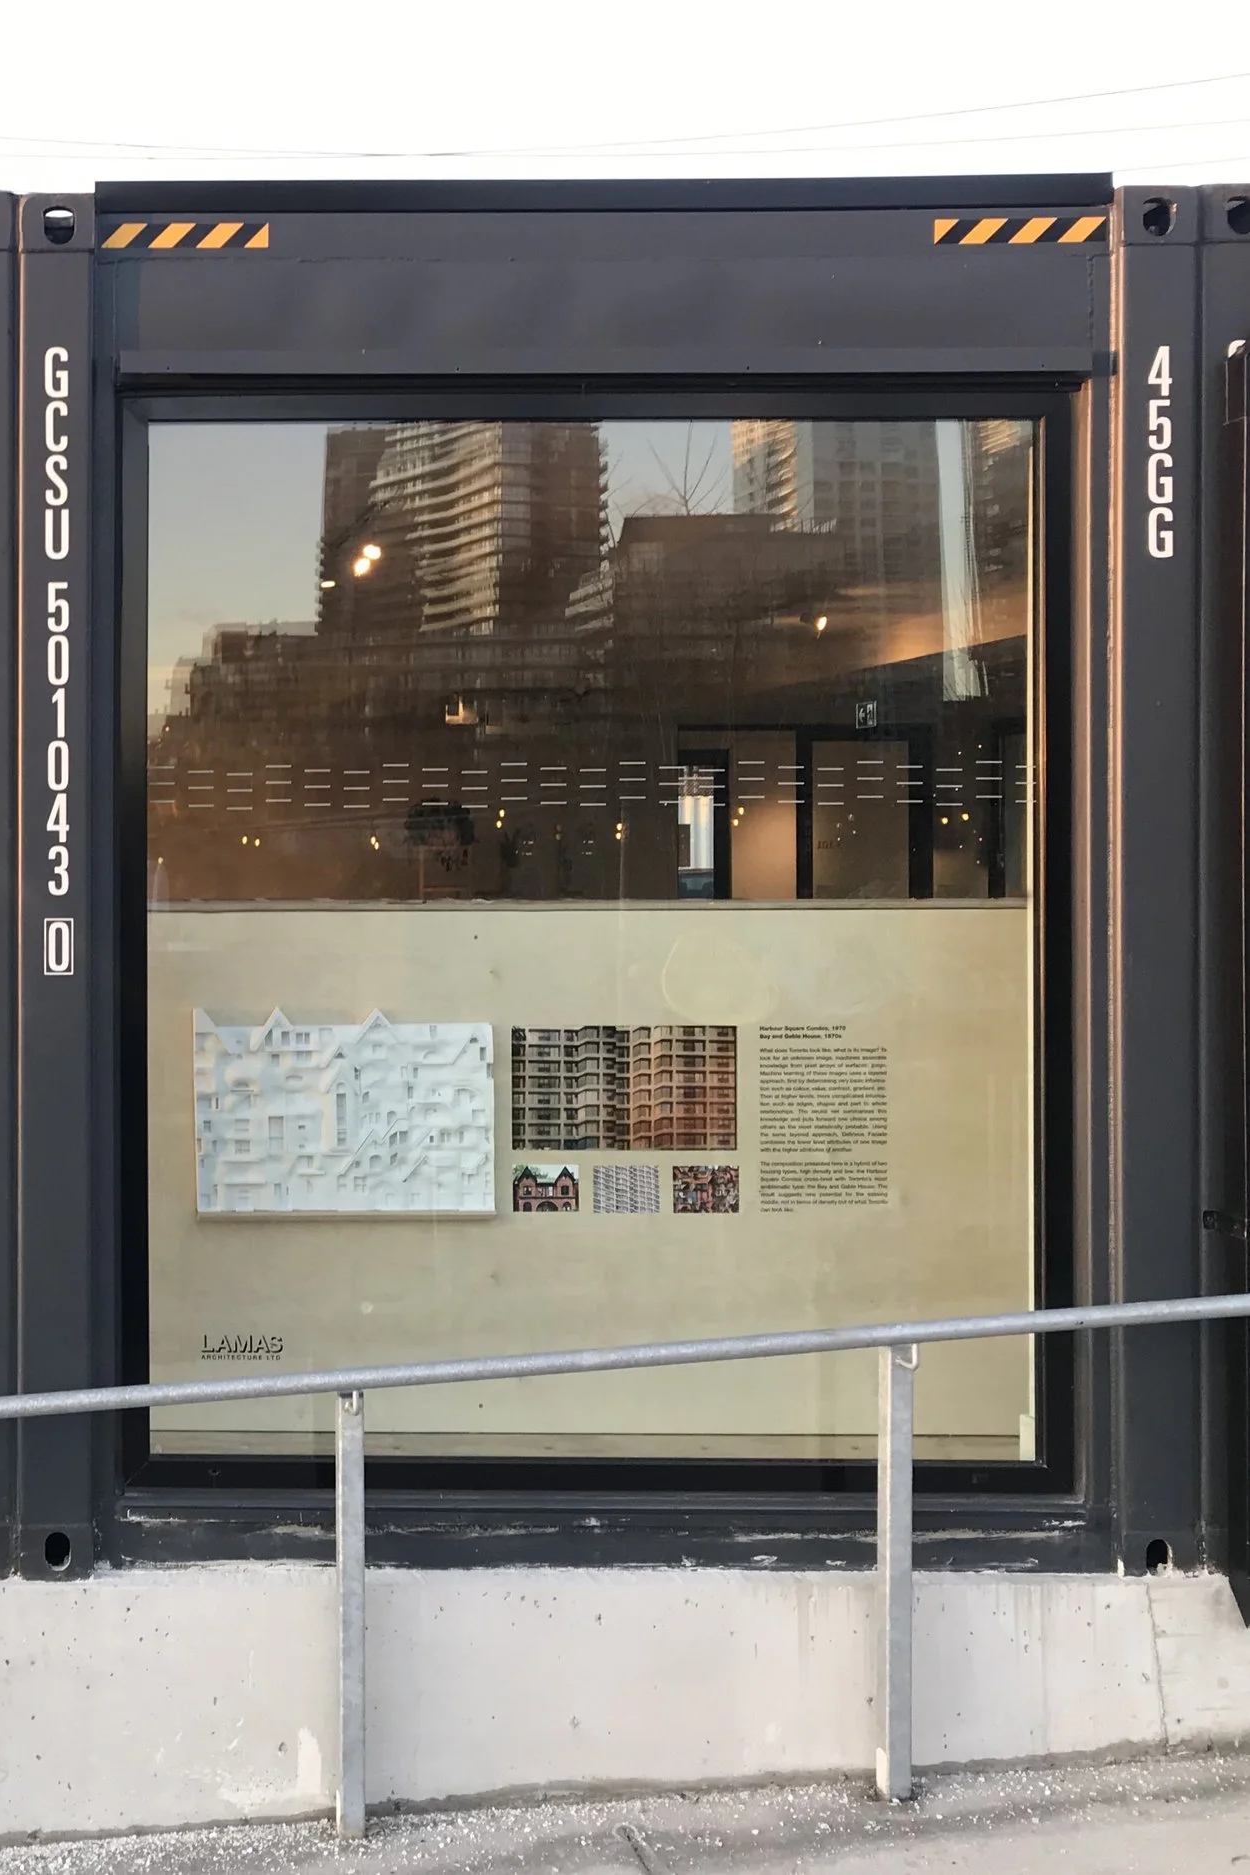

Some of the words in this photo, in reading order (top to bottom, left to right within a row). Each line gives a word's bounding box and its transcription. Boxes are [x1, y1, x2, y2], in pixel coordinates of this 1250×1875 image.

[44, 347, 69, 561] GCSU
[1147, 345, 1174, 559] 45GG
[47, 581, 70, 896] 501043
[760, 1033, 770, 1041] Bay
[802, 1033, 822, 1041] House,
[784, 1025, 804, 1033] Square
[806, 1025, 829, 1033] Condos,
[201, 1334, 283, 1353] LAMAS
